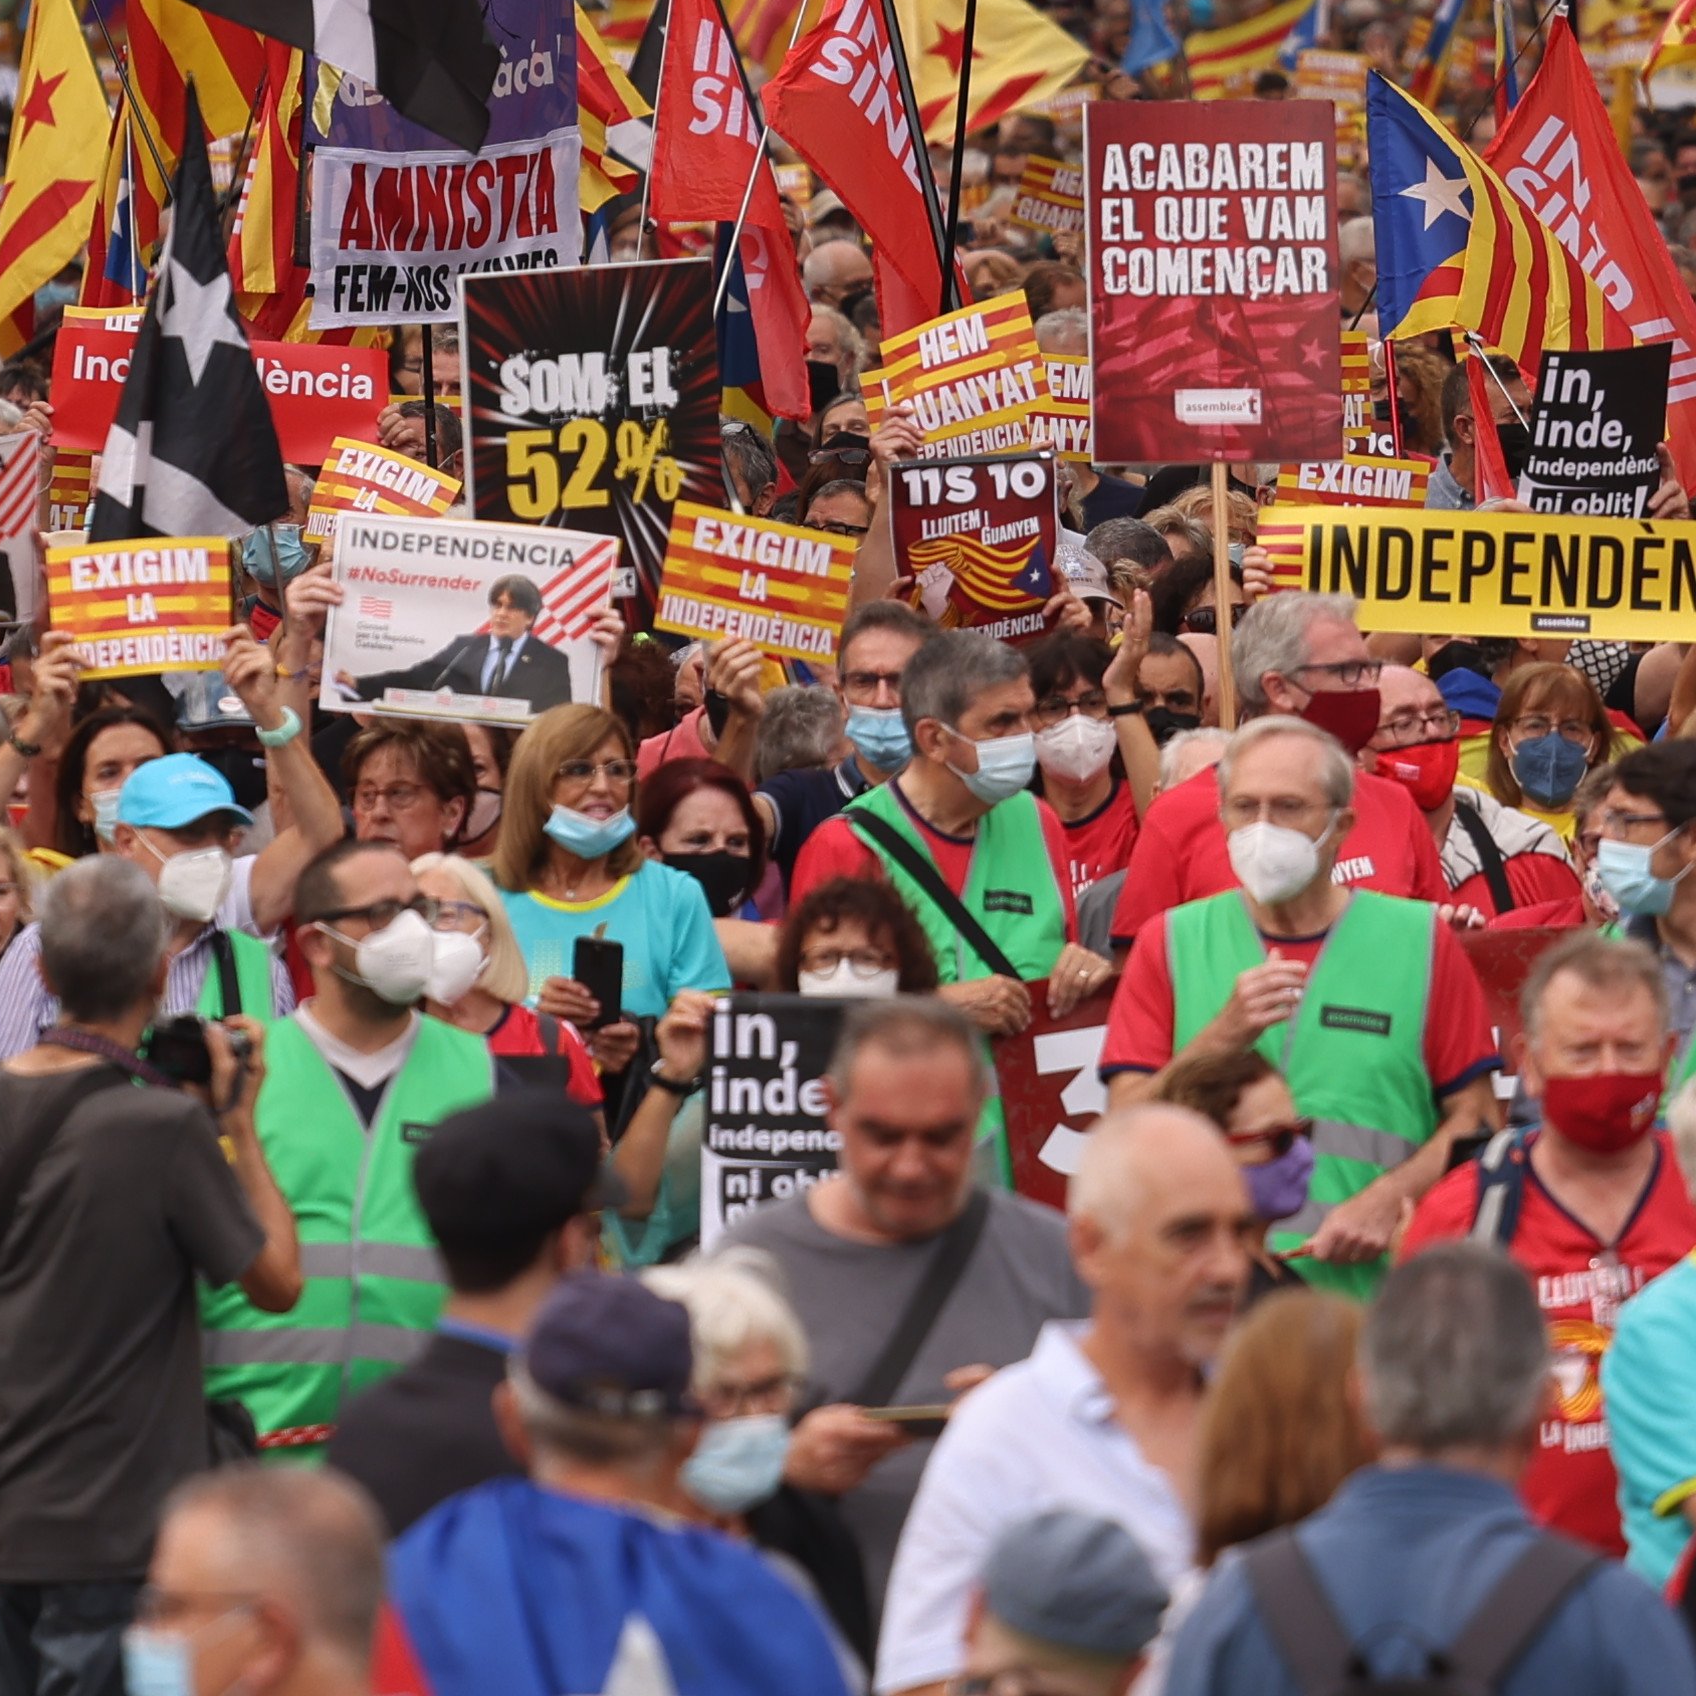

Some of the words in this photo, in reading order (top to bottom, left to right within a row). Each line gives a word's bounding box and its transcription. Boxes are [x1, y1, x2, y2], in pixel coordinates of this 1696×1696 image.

[1101, 142, 1325, 192] ACABAREM
[338, 147, 559, 252] AMNISTIA
[1101, 196, 1143, 242] EL
[1154, 195, 1229, 244] QUE
[1241, 194, 1326, 242] VAM
[1101, 246, 1328, 301] COMENÇAR
[918, 312, 989, 370] HEM
[499, 351, 606, 417] SOM
[627, 346, 680, 408] EL
[1542, 356, 1606, 412] in,
[1534, 409, 1633, 452] inde,
[335, 447, 441, 507] EXIGIM
[505, 416, 688, 520] 52%
[1297, 462, 1412, 500] EXIGIM
[352, 486, 380, 512] LA
[692, 515, 835, 578] EXIGIM
[920, 508, 981, 540] LLUITEM
[981, 516, 1042, 547] GUANYEM
[70, 548, 211, 591] EXIGIM
[351, 527, 576, 569] INDEPENDÈNCIA
[346, 565, 481, 592] #NoSurrender
[738, 569, 768, 603] LA
[126, 592, 159, 624] LA
[660, 596, 835, 656] INDEPENDÈNCIA
[1536, 617, 1586, 629] assemblea
[713, 997, 799, 1070] in,
[725, 1168, 762, 1197] ni
